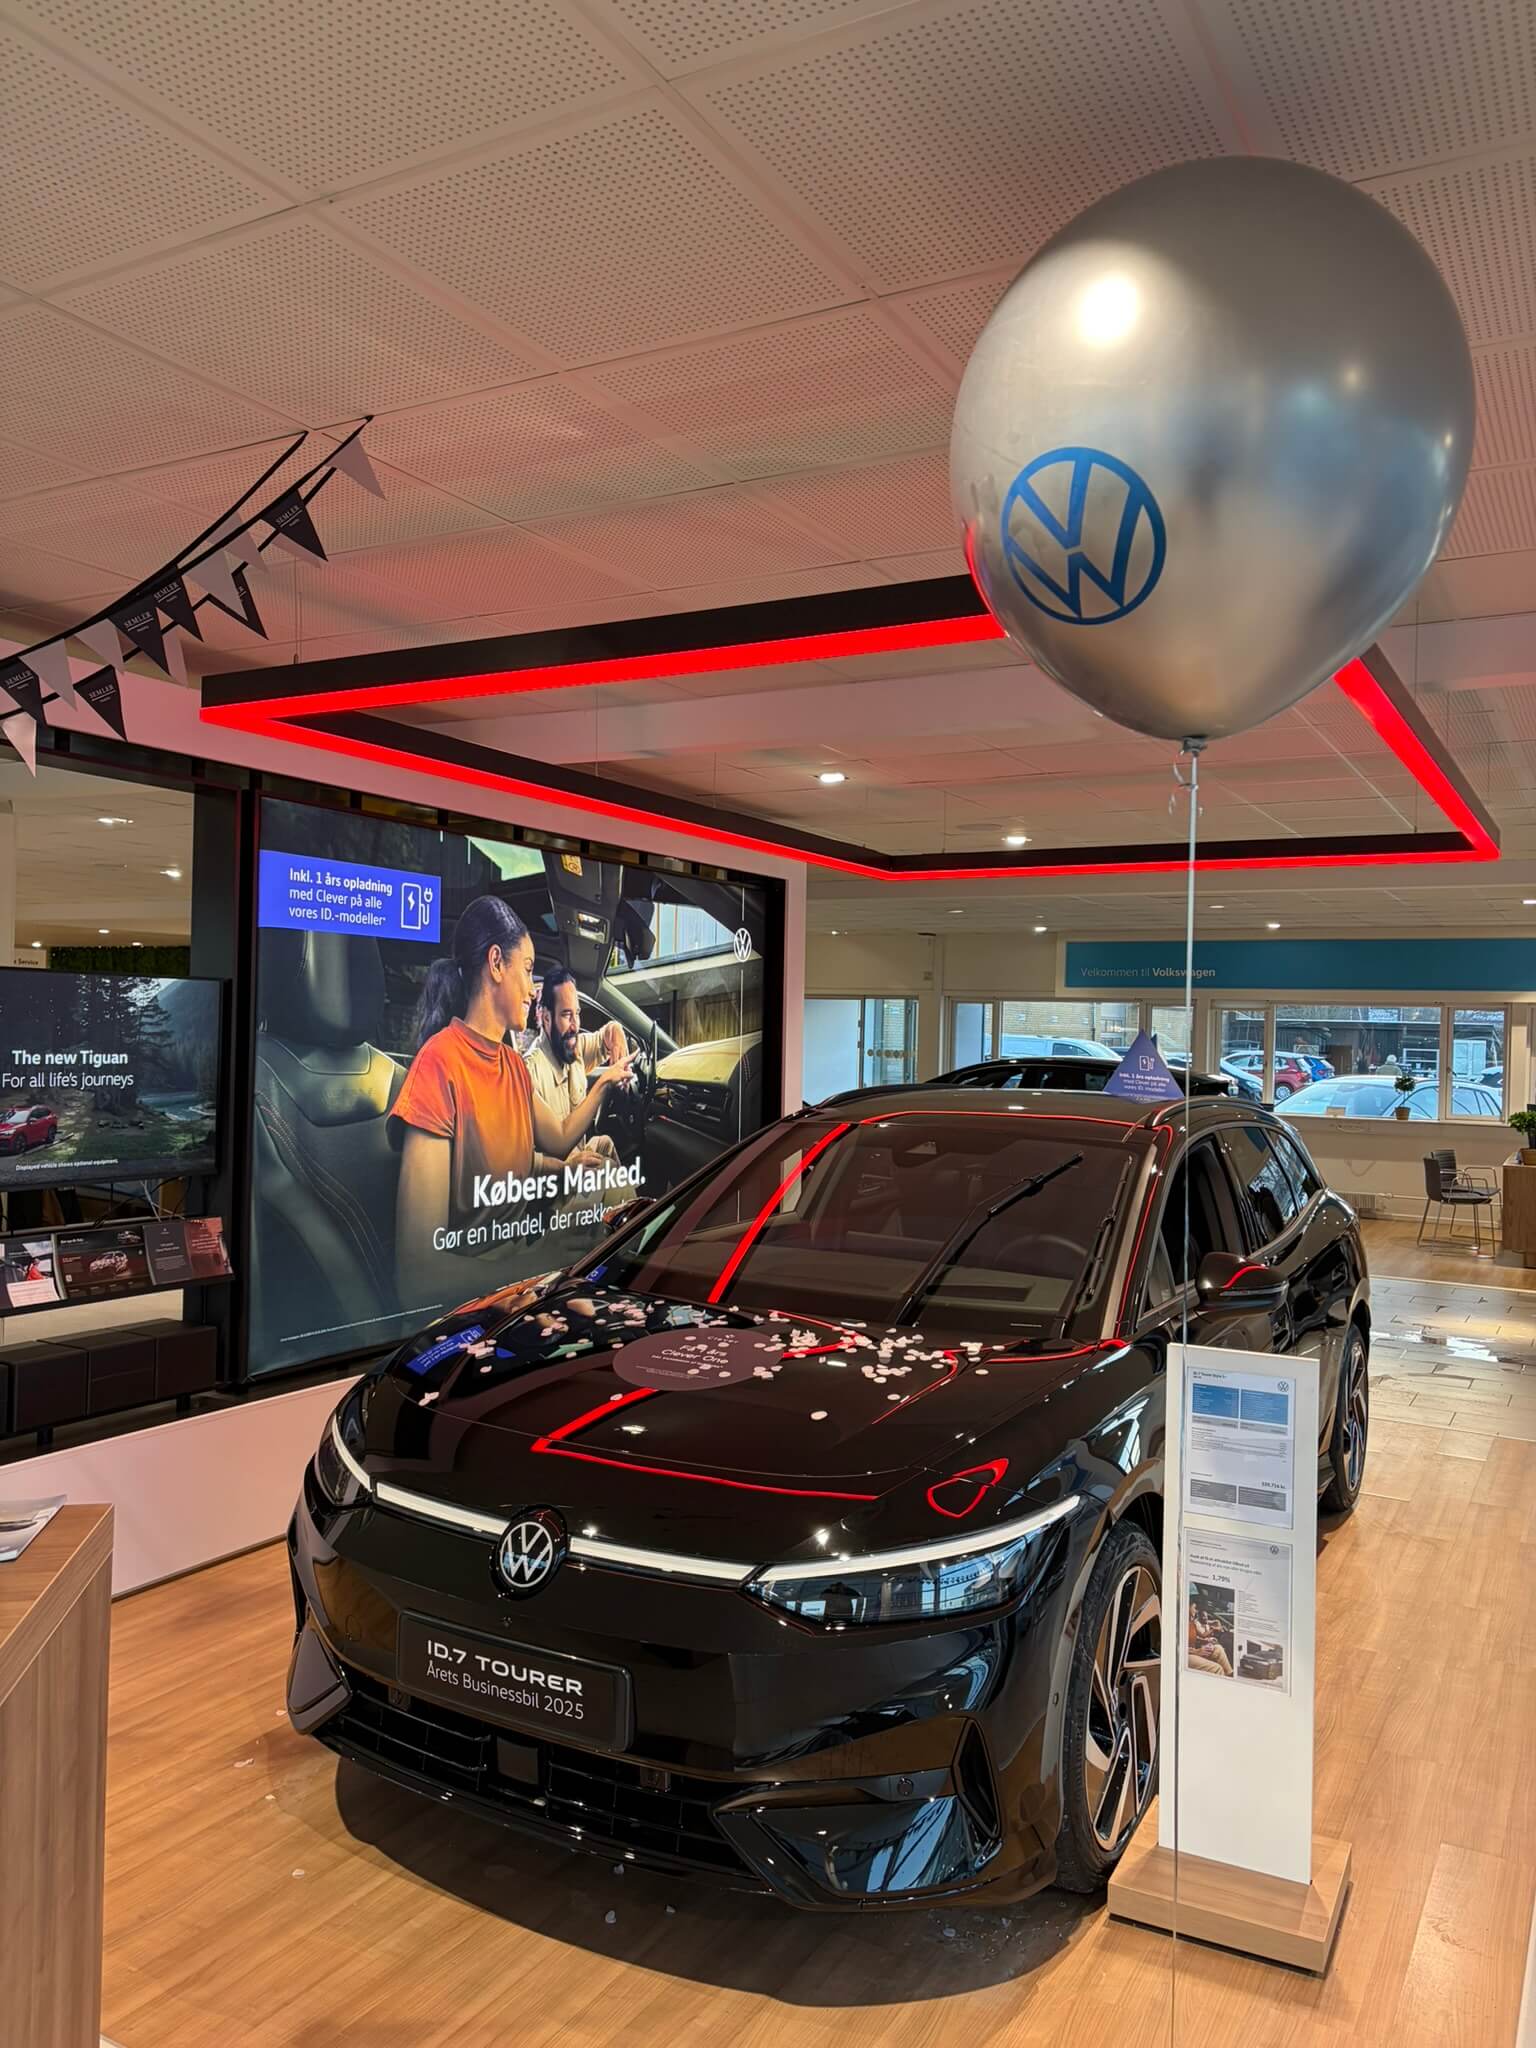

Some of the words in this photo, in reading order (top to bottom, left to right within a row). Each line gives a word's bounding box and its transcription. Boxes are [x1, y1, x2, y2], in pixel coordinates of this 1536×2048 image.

[153, 582, 180, 600] SEMLER
[124, 611, 151, 627] SEMLER
[5, 670, 33, 686] SEMLER
[88, 684, 116, 699] SEMLER
[289, 867, 313, 884] Inkl.
[315, 871, 323, 884] 1
[324, 872, 342, 888] års
[343, 876, 393, 897] opladning
[289, 887, 313, 901] med
[315, 888, 349, 905] Clever
[350, 893, 363, 909] på
[364, 895, 383, 910] alle
[288, 906, 318, 920] vores
[1080, 966, 1139, 977] Velkommen
[1141, 967, 1150, 977] til
[12, 1049, 41, 1065] The
[45, 1052, 78, 1065] new
[80, 1049, 129, 1068] Tiguan
[2, 1072, 26, 1089] For
[29, 1072, 46, 1088] all
[49, 1071, 78, 1088] life's
[80, 1072, 134, 1090] journeys
[472, 1170, 558, 1209] Købers
[563, 1156, 646, 1196] Marked.
[433, 1226, 463, 1250] Gør
[467, 1225, 487, 1245] en
[491, 1211, 545, 1243] handel,
[550, 1208, 573, 1231] der
[427, 1639, 467, 1665] ID.7
[475, 1655, 584, 1697] TOURER
[426, 1661, 459, 1686] Årets
[463, 1673, 540, 1708] Businessbil
[544, 1696, 585, 1720] 2025
